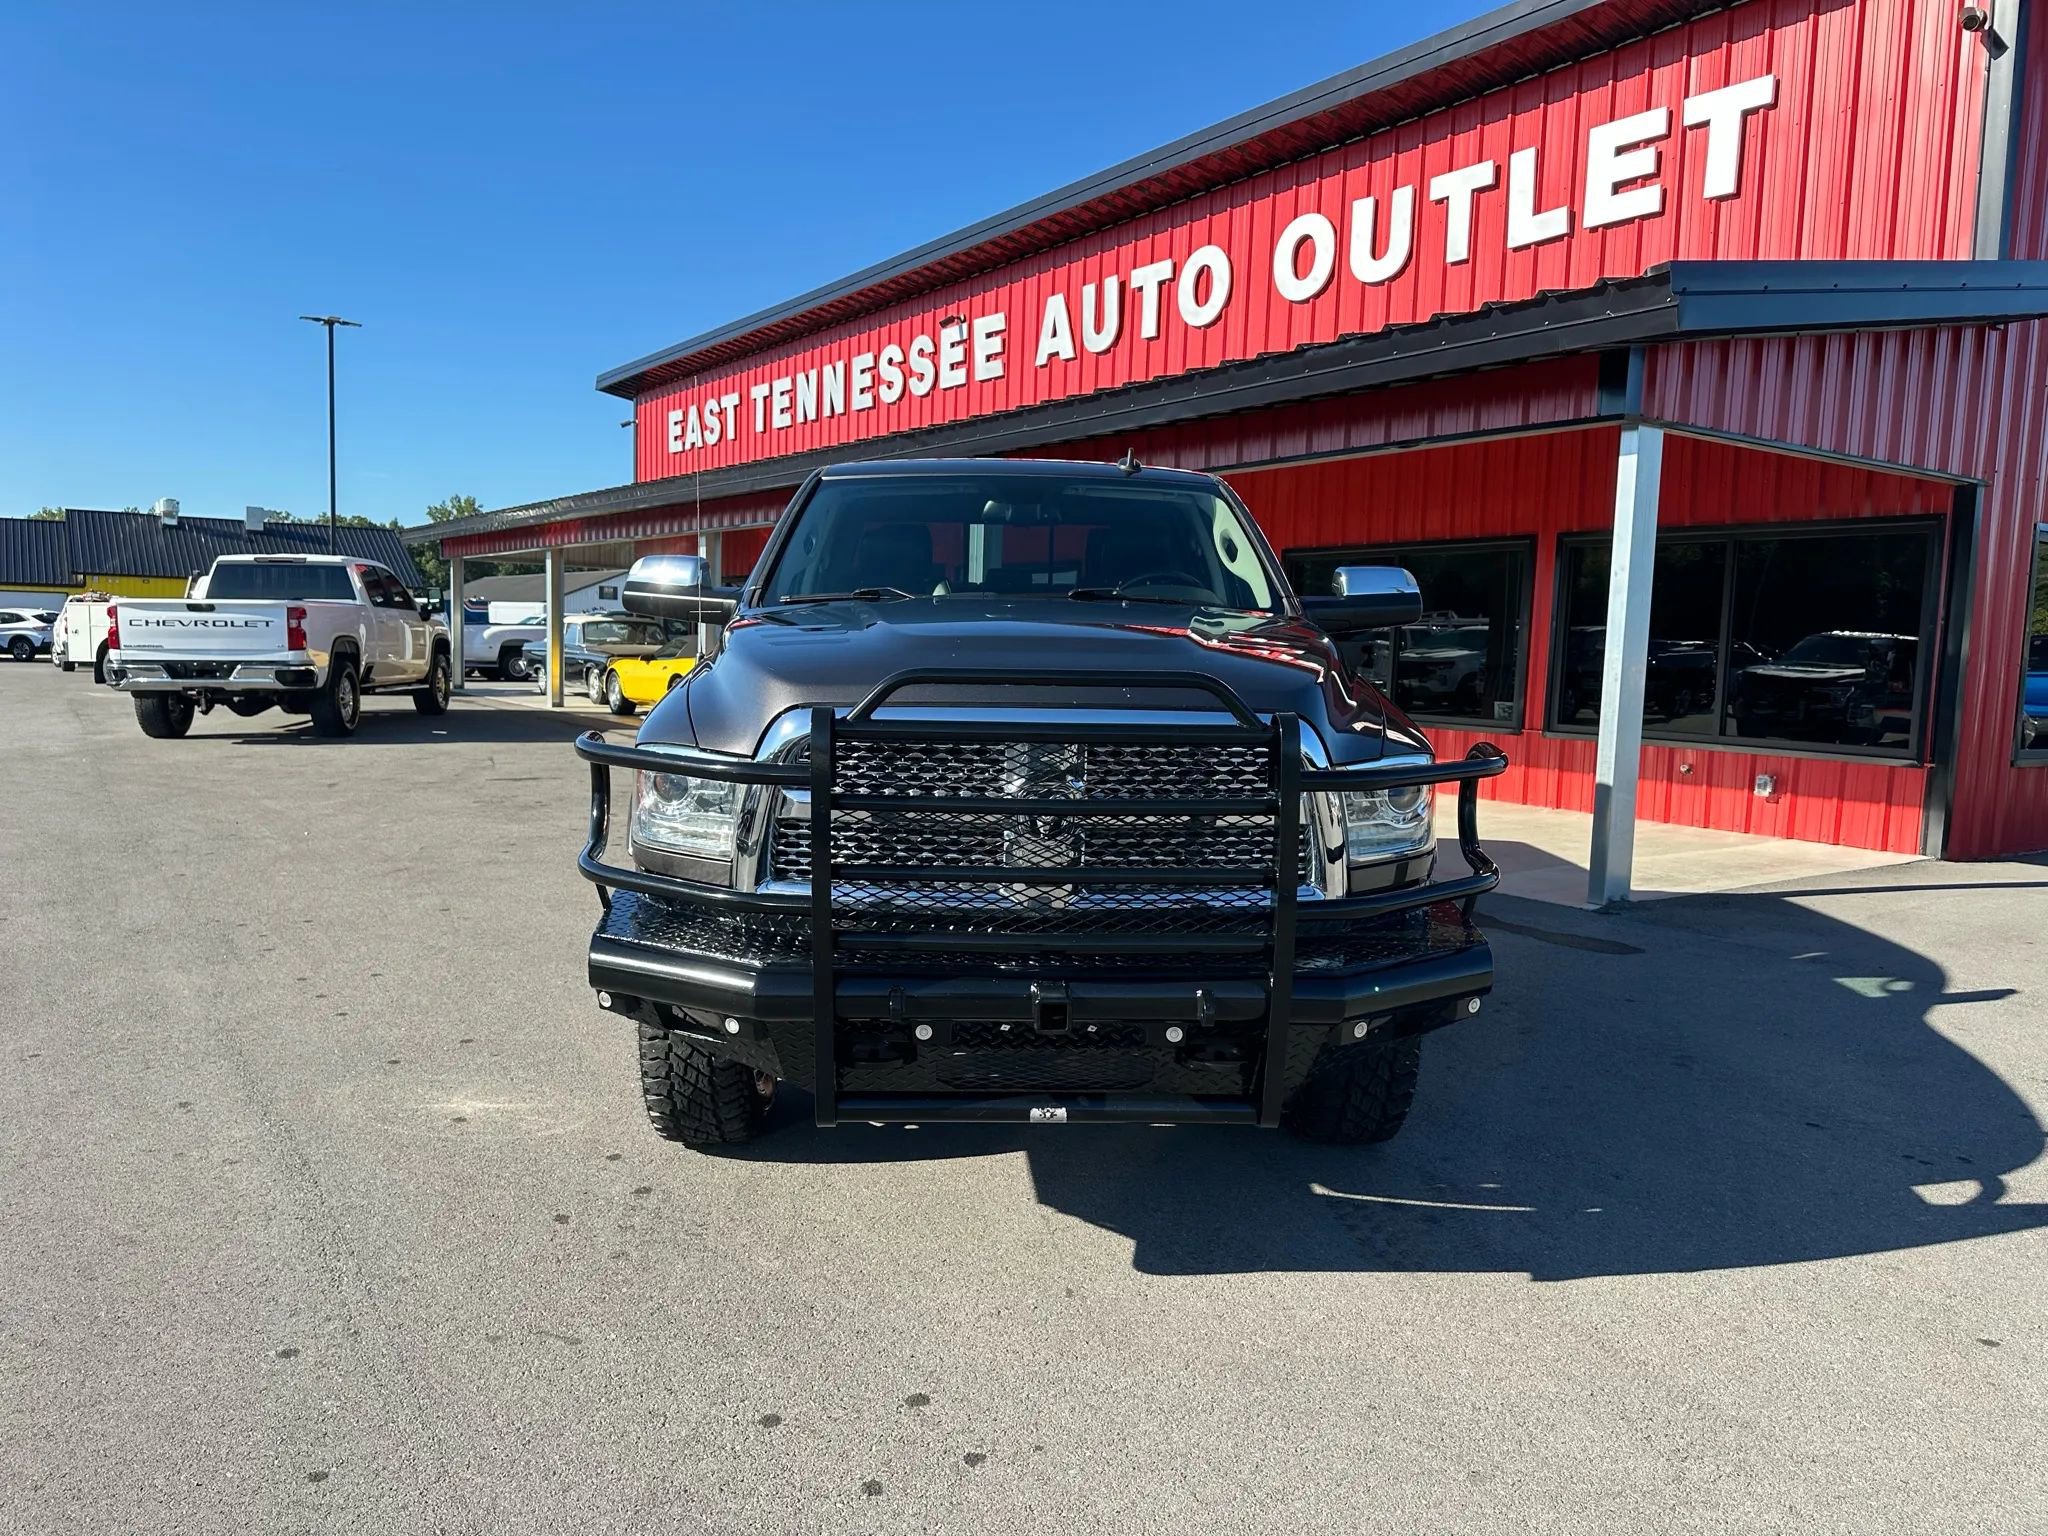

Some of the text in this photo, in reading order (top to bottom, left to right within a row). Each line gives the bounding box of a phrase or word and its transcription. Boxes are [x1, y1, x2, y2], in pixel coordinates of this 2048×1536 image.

[668, 74, 1777, 453] EAST TENNESSEE AUTO OUTLET
[128, 618, 275, 628] CHEVROLET
